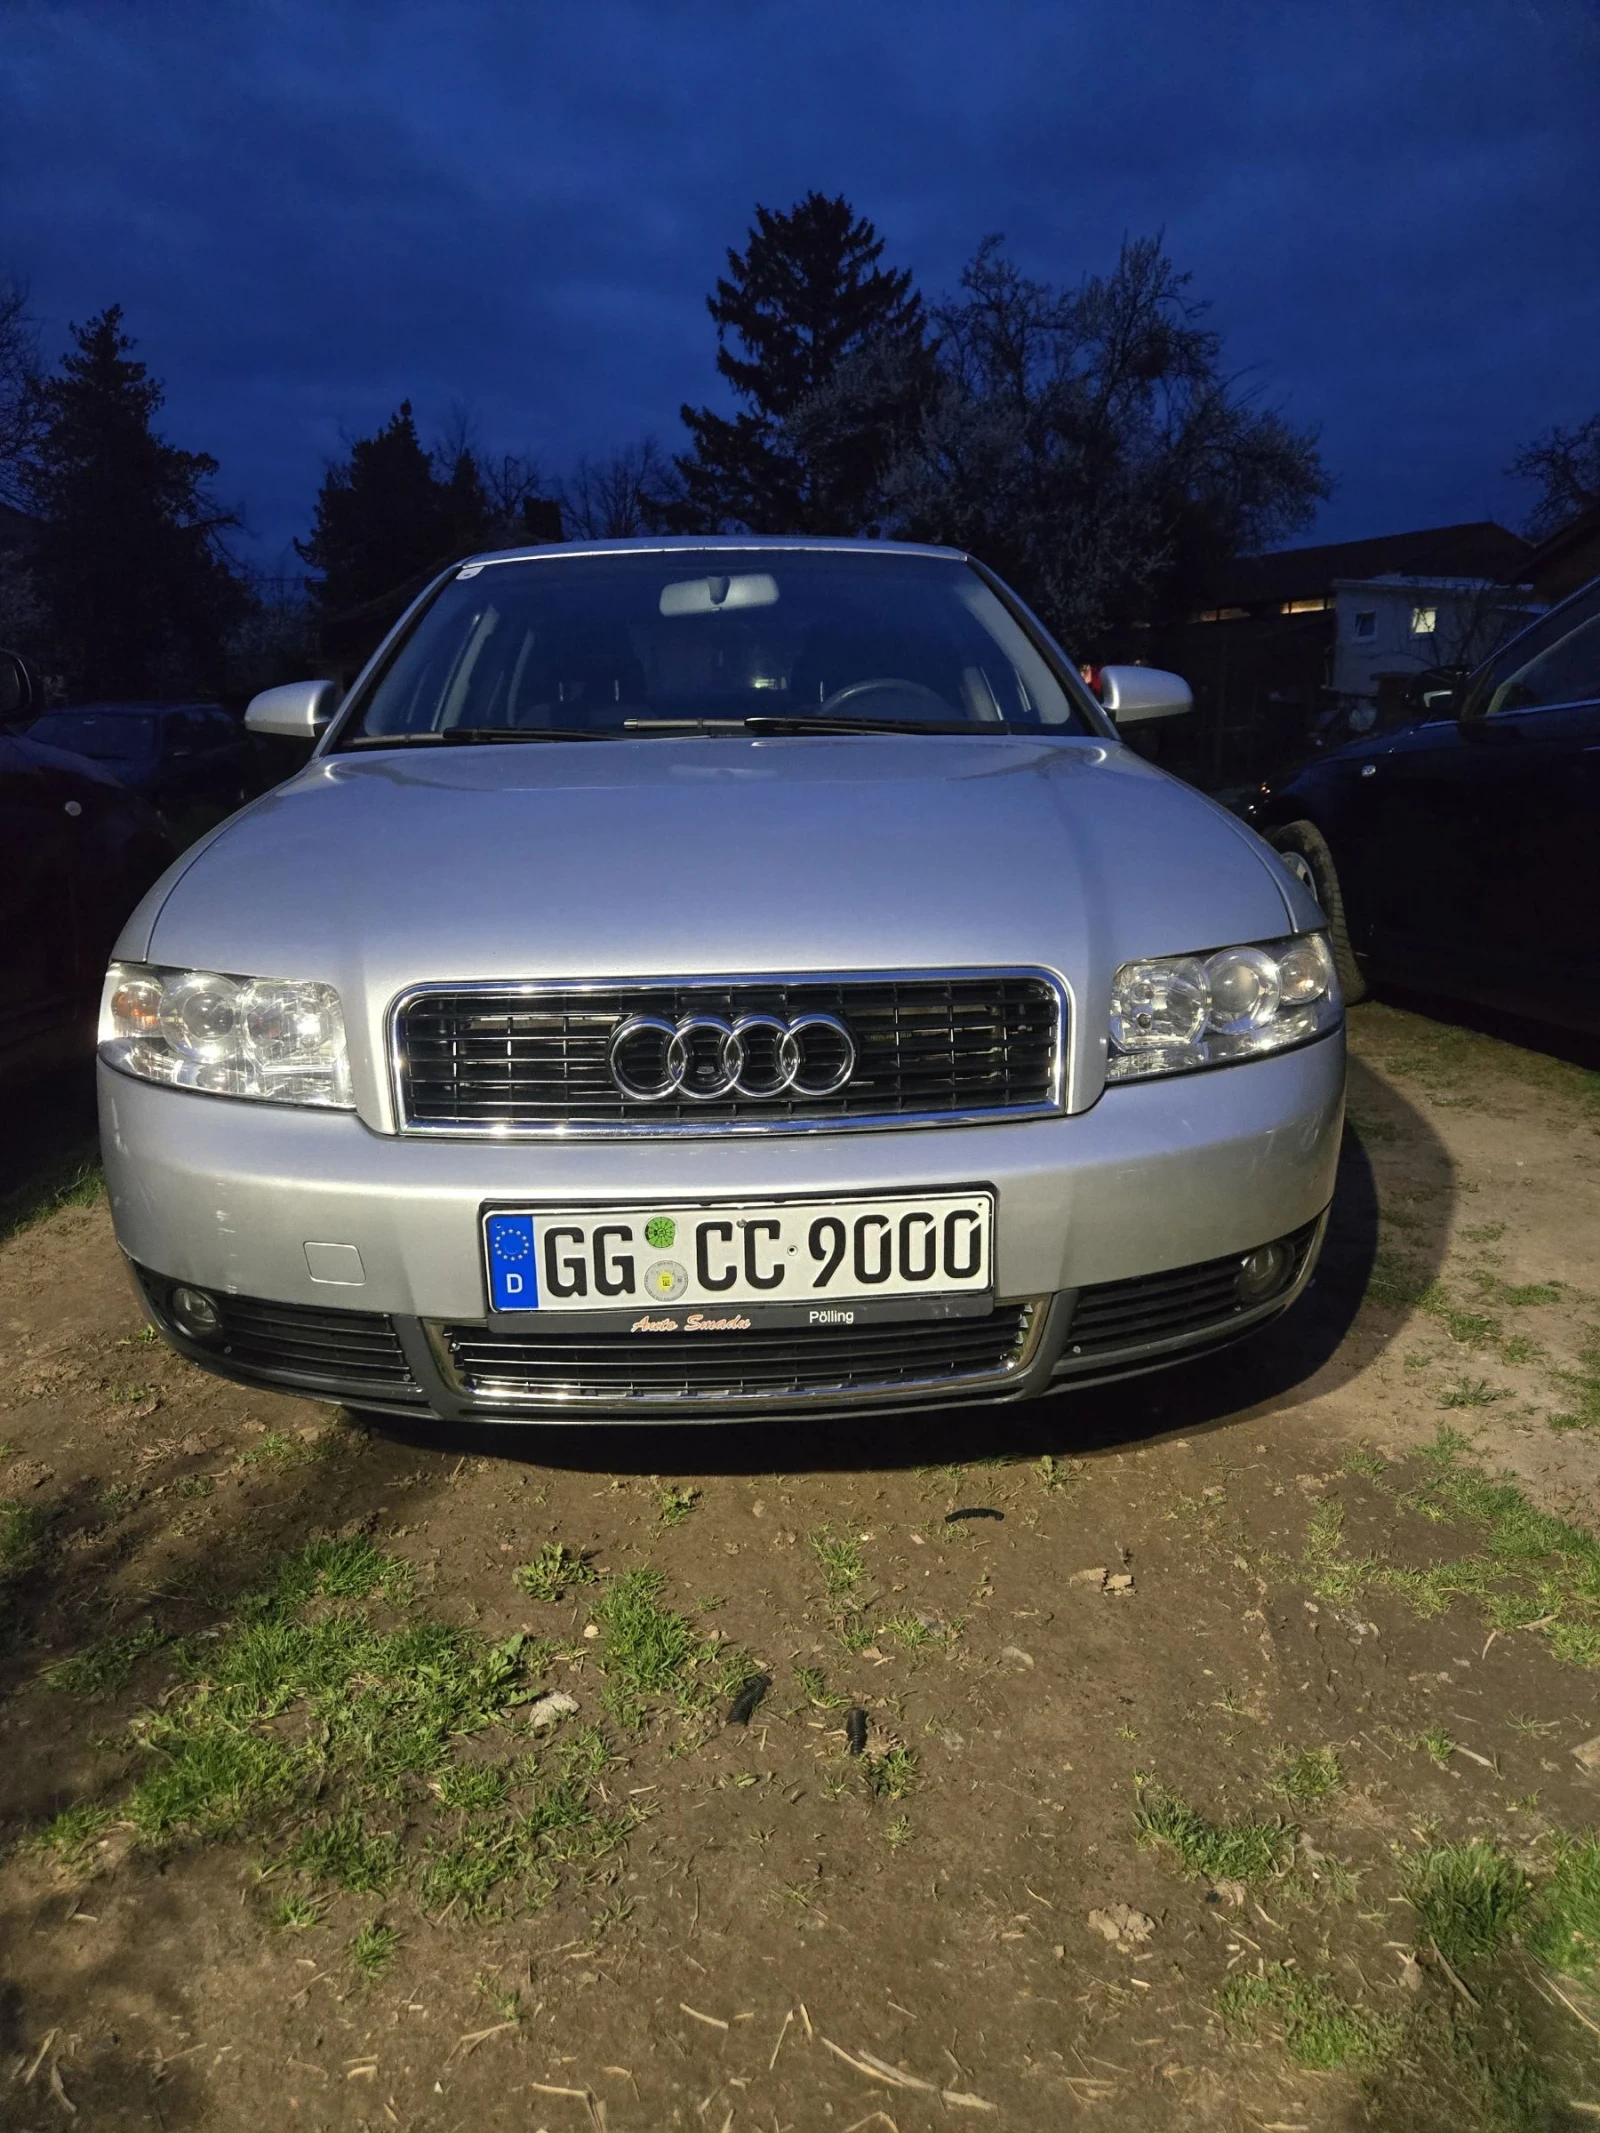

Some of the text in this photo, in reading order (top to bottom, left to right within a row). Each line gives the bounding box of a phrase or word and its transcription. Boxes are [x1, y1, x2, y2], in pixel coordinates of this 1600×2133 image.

[544, 1226, 637, 1298] GG
[696, 1219, 785, 1291] CC
[808, 1209, 981, 1288] 9000
[506, 1273, 523, 1294] D
[630, 1315, 679, 1333] Auto
[809, 1310, 854, 1325] Pölling
